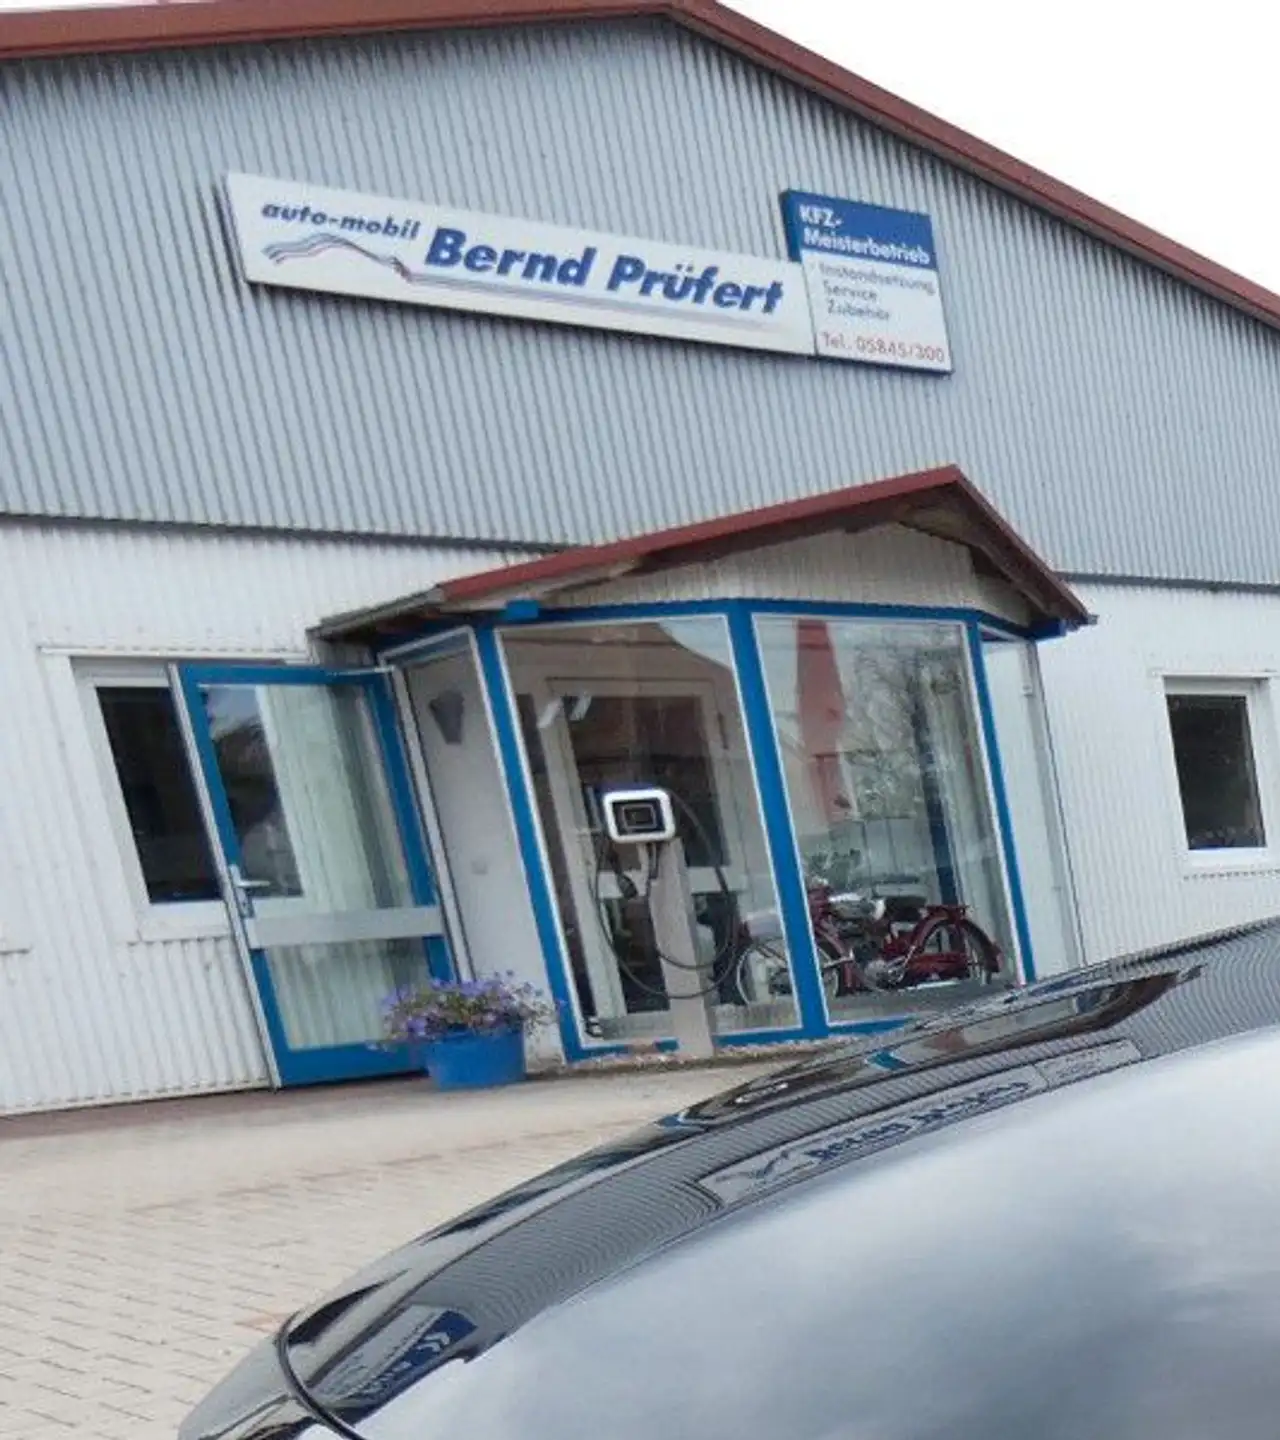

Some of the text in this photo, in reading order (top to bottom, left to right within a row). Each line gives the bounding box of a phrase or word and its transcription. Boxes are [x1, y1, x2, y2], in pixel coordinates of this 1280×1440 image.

[262, 203, 422, 240] auto-mobil
[799, 204, 842, 228] KFZ-
[803, 228, 931, 265] Meisterbetrieb
[424, 227, 784, 314] Bernd Prüfert
[823, 280, 878, 302] Service
